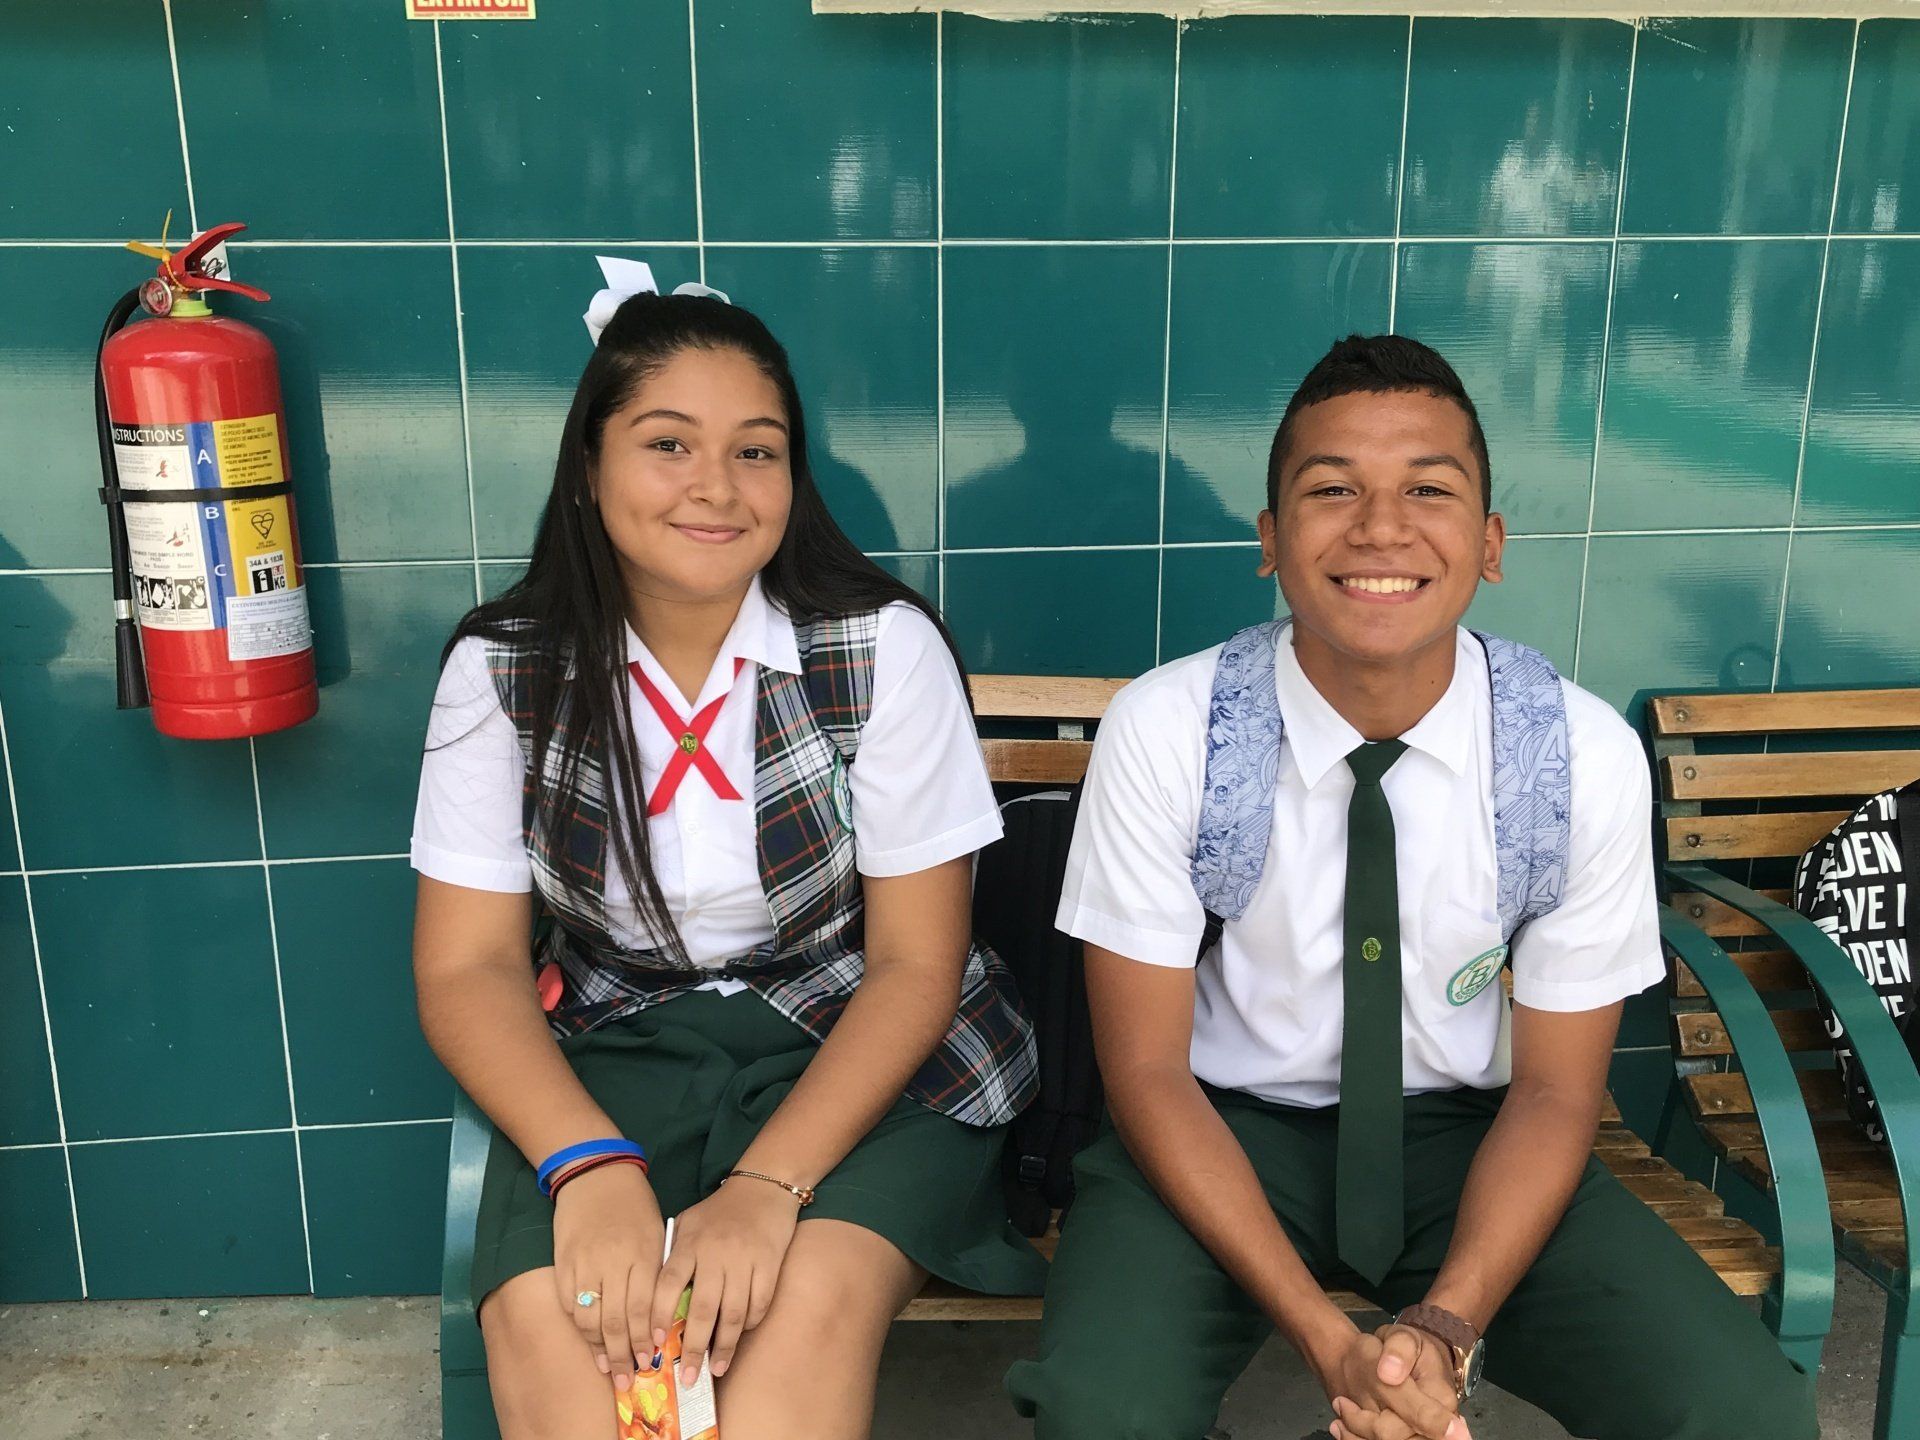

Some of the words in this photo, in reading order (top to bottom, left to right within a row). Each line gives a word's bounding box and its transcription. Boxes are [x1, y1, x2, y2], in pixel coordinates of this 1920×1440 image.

[197, 448, 212, 465] A
[205, 506, 220, 519] B
[214, 563, 227, 576] C
[274, 575, 286, 590] KG
